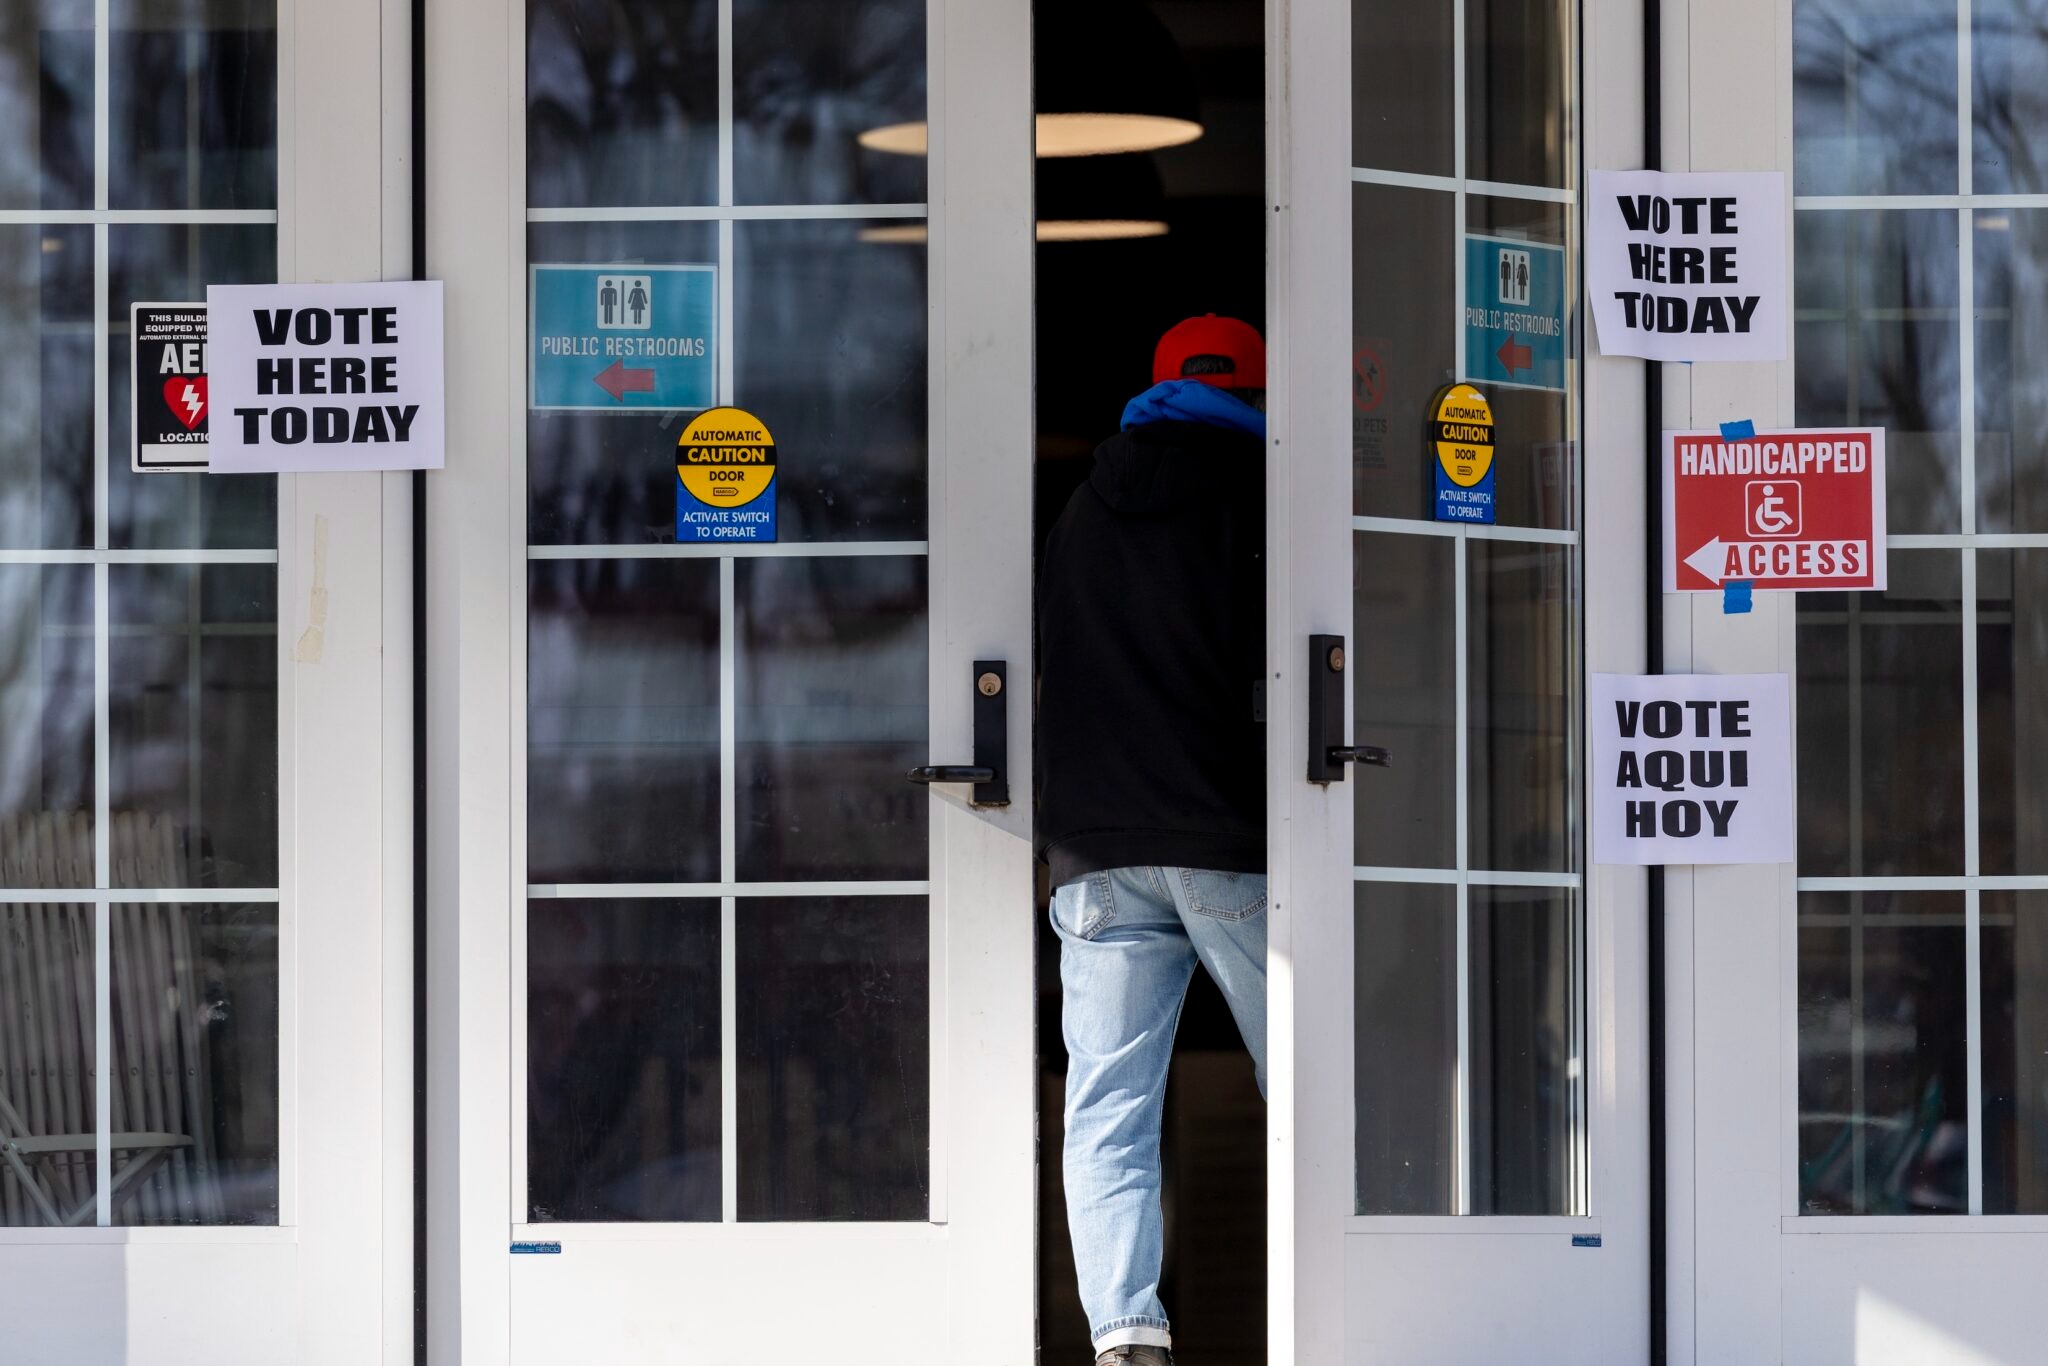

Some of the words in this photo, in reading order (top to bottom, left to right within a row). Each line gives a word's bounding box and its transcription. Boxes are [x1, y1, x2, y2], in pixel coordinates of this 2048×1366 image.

[1616, 195, 1738, 234] VOTE
[1627, 243, 1738, 284] HERE
[149, 314, 172, 322] THIS
[174, 314, 208, 322] BUILDI
[1466, 307, 1500, 329] PUBLIC
[1503, 312, 1560, 336] RESTROOMS
[1614, 291, 1761, 333] TODAY
[145, 324, 193, 332] EQUIPPED
[195, 324, 207, 332] WI
[253, 307, 398, 345] VOTE
[541, 336, 599, 356] PUBLIC
[605, 337, 705, 357] RESTROOMS
[257, 356, 398, 395] HERE
[1445, 406, 1486, 420] AUTOMATIC
[234, 405, 420, 444] TODAY
[1442, 424, 1488, 442] CAUTION
[692, 430, 762, 441] AUTOMATIC
[687, 447, 766, 463] CAUTION
[1455, 448, 1476, 461] DOOR
[1681, 441, 1867, 477] HANDICAPPED
[709, 471, 745, 481] DOOR
[1440, 489, 1467, 502] ACTIVATE
[1468, 491, 1491, 504] SWITCH
[683, 511, 729, 523] ACTIVATE
[732, 511, 770, 523] SWITCH
[1448, 505, 1456, 516] TO
[1457, 506, 1483, 519] OPERATE
[696, 526, 711, 537] TO
[713, 526, 757, 537] OPERATE
[1724, 543, 1860, 576] ACCESS
[1615, 700, 1751, 738] VOTE
[1616, 750, 1748, 791] AQUI
[1625, 799, 1739, 838] HOY
